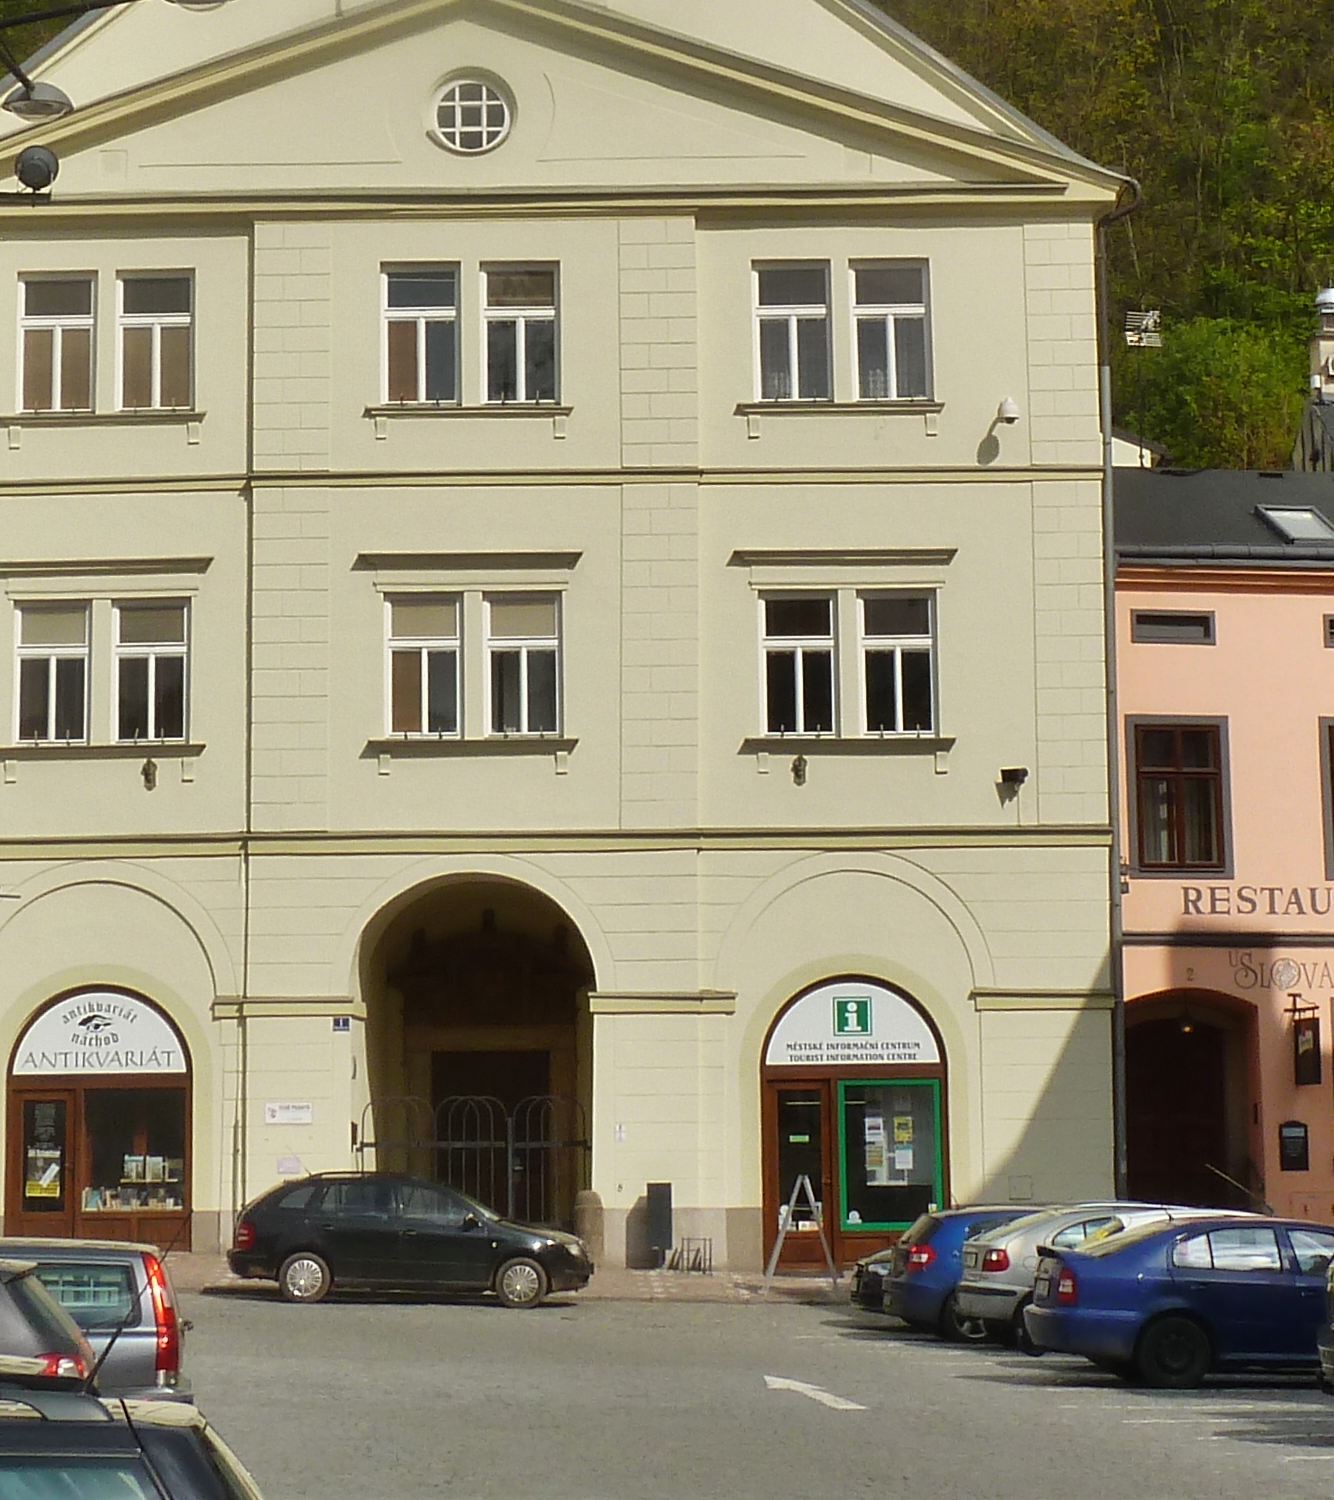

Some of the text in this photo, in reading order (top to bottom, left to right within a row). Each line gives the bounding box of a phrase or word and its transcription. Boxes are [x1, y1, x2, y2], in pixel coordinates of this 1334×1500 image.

[61, 1001, 140, 1025] antikvariát
[70, 1031, 120, 1047] náchod
[826, 1041, 879, 1051] INFORMAČNÍ
[880, 1041, 921, 1050] CENTRUM
[21, 1046, 176, 1069] ANTIKVARIÁT
[789, 1052, 918, 1062] TOURIST INFORMATION CENTRE
